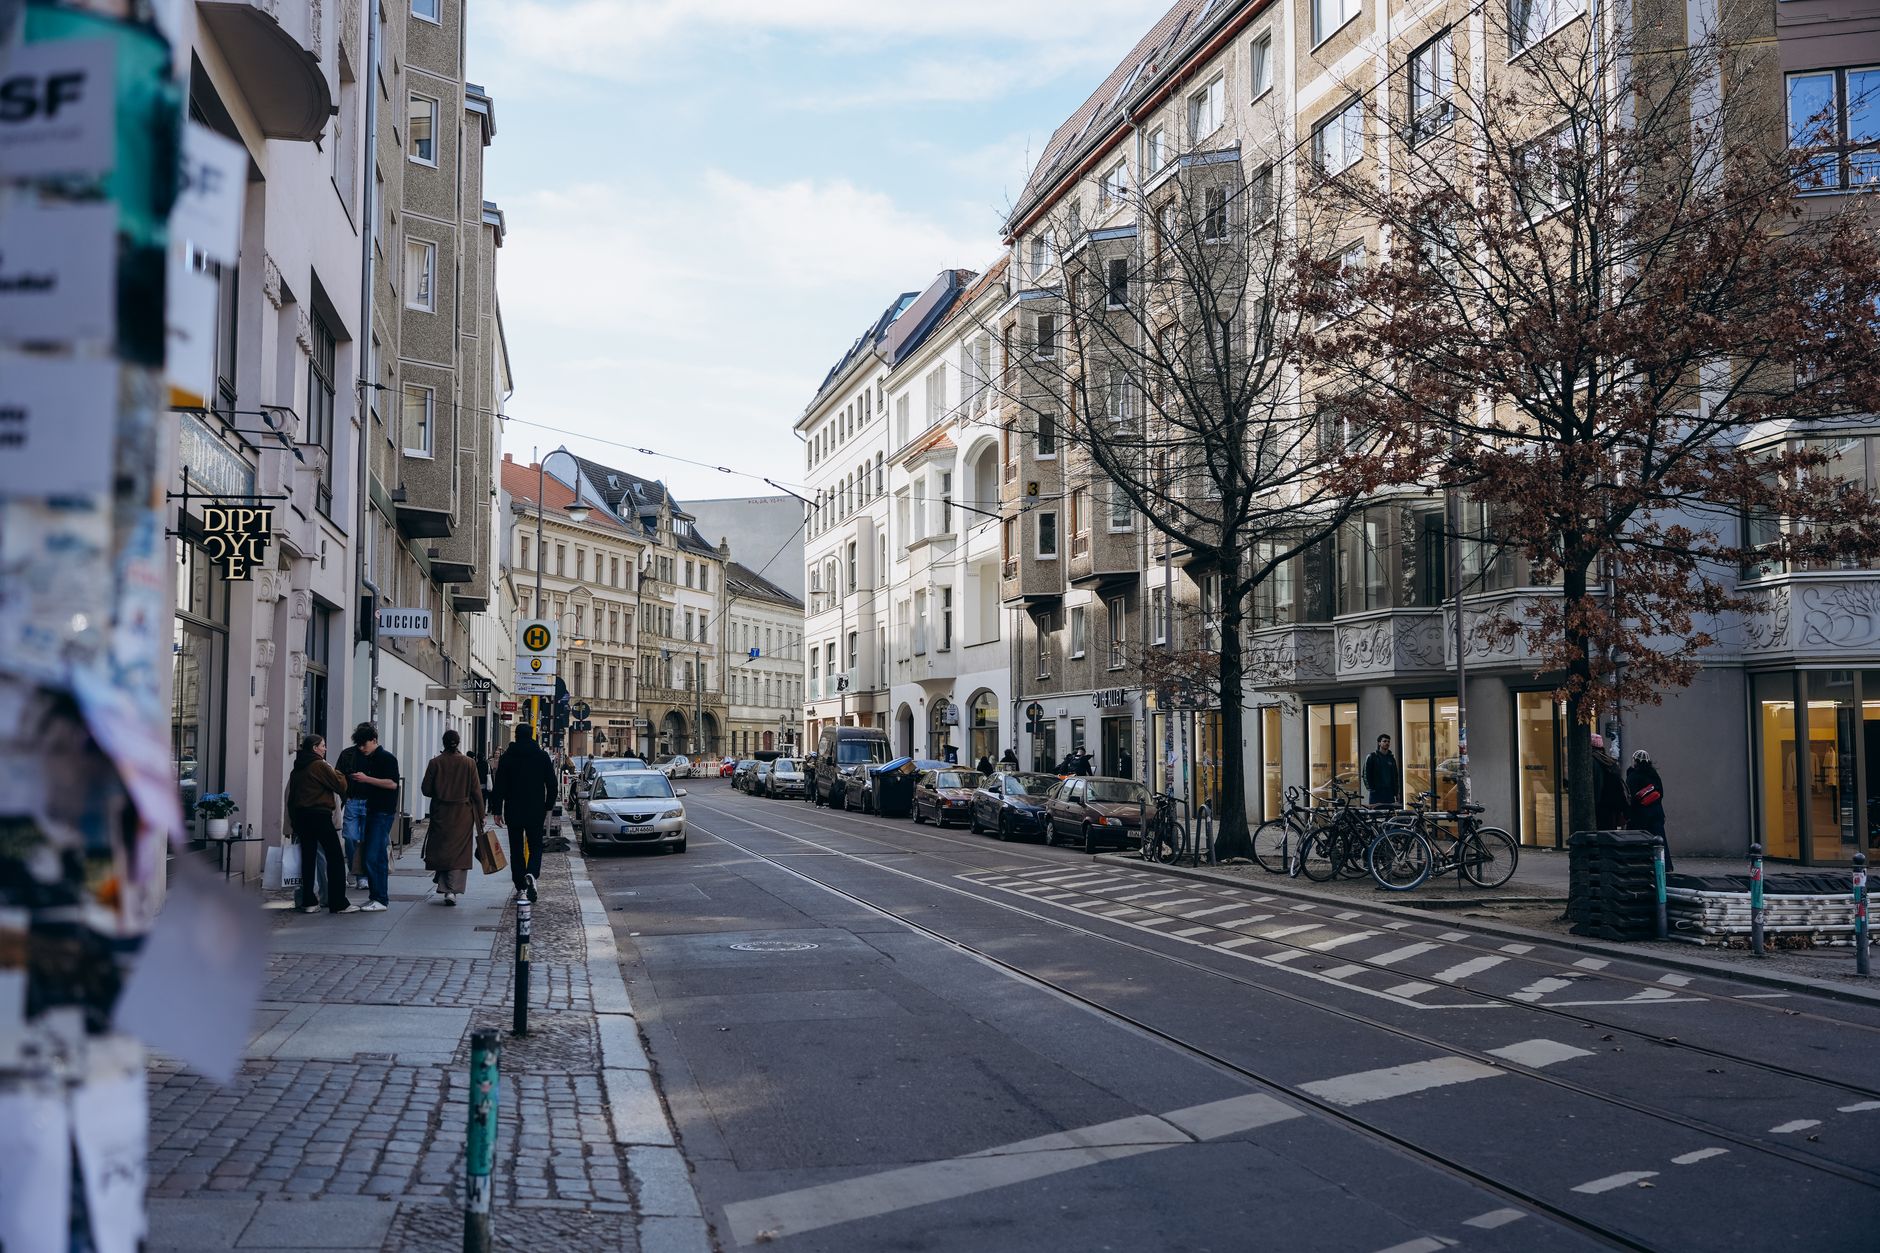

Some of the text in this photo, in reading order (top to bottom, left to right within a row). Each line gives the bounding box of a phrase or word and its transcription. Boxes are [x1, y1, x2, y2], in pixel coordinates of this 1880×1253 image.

[1029, 482, 1038, 496] 3
[204, 508, 272, 533] DIPT
[225, 556, 246, 580] E
[379, 615, 428, 629] LUCCICO
[530, 630, 544, 645] H
